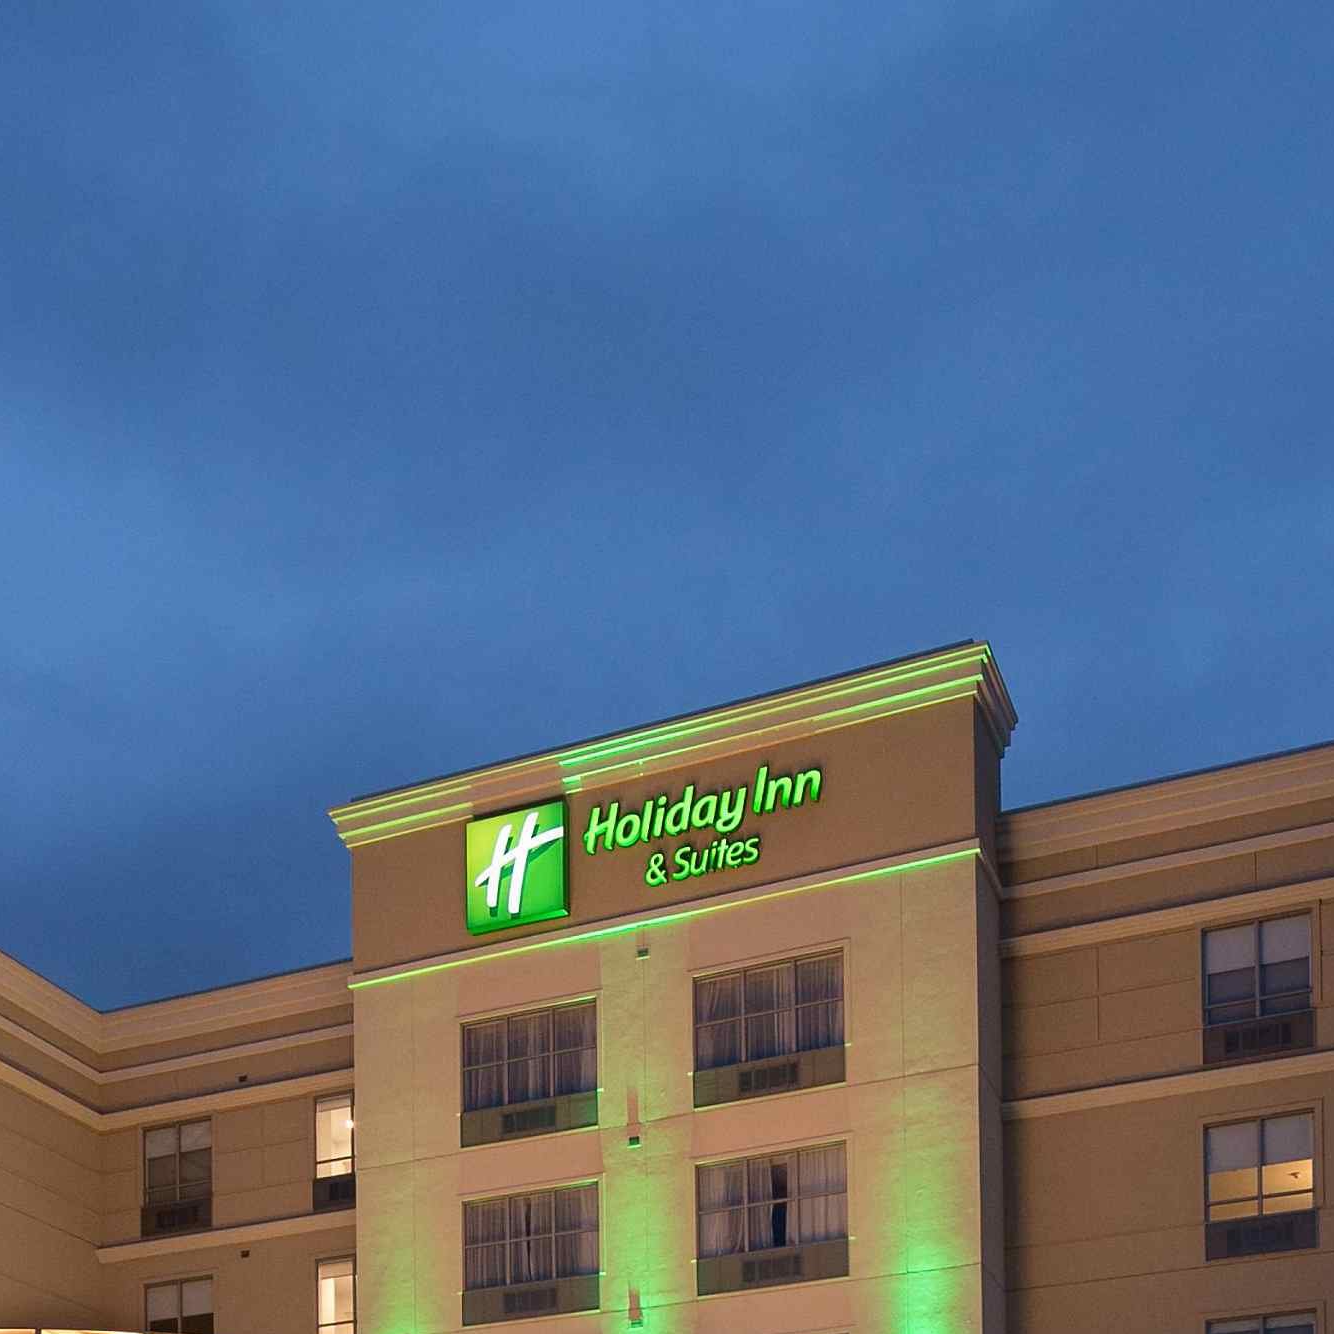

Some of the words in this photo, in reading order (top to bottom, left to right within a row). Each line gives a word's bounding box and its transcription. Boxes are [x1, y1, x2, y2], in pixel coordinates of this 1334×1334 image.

[584, 785, 746, 855] Holiday
[752, 766, 822, 815] Inn
[475, 812, 564, 912] H
[645, 853, 668, 886] &
[672, 837, 760, 880] Suites
